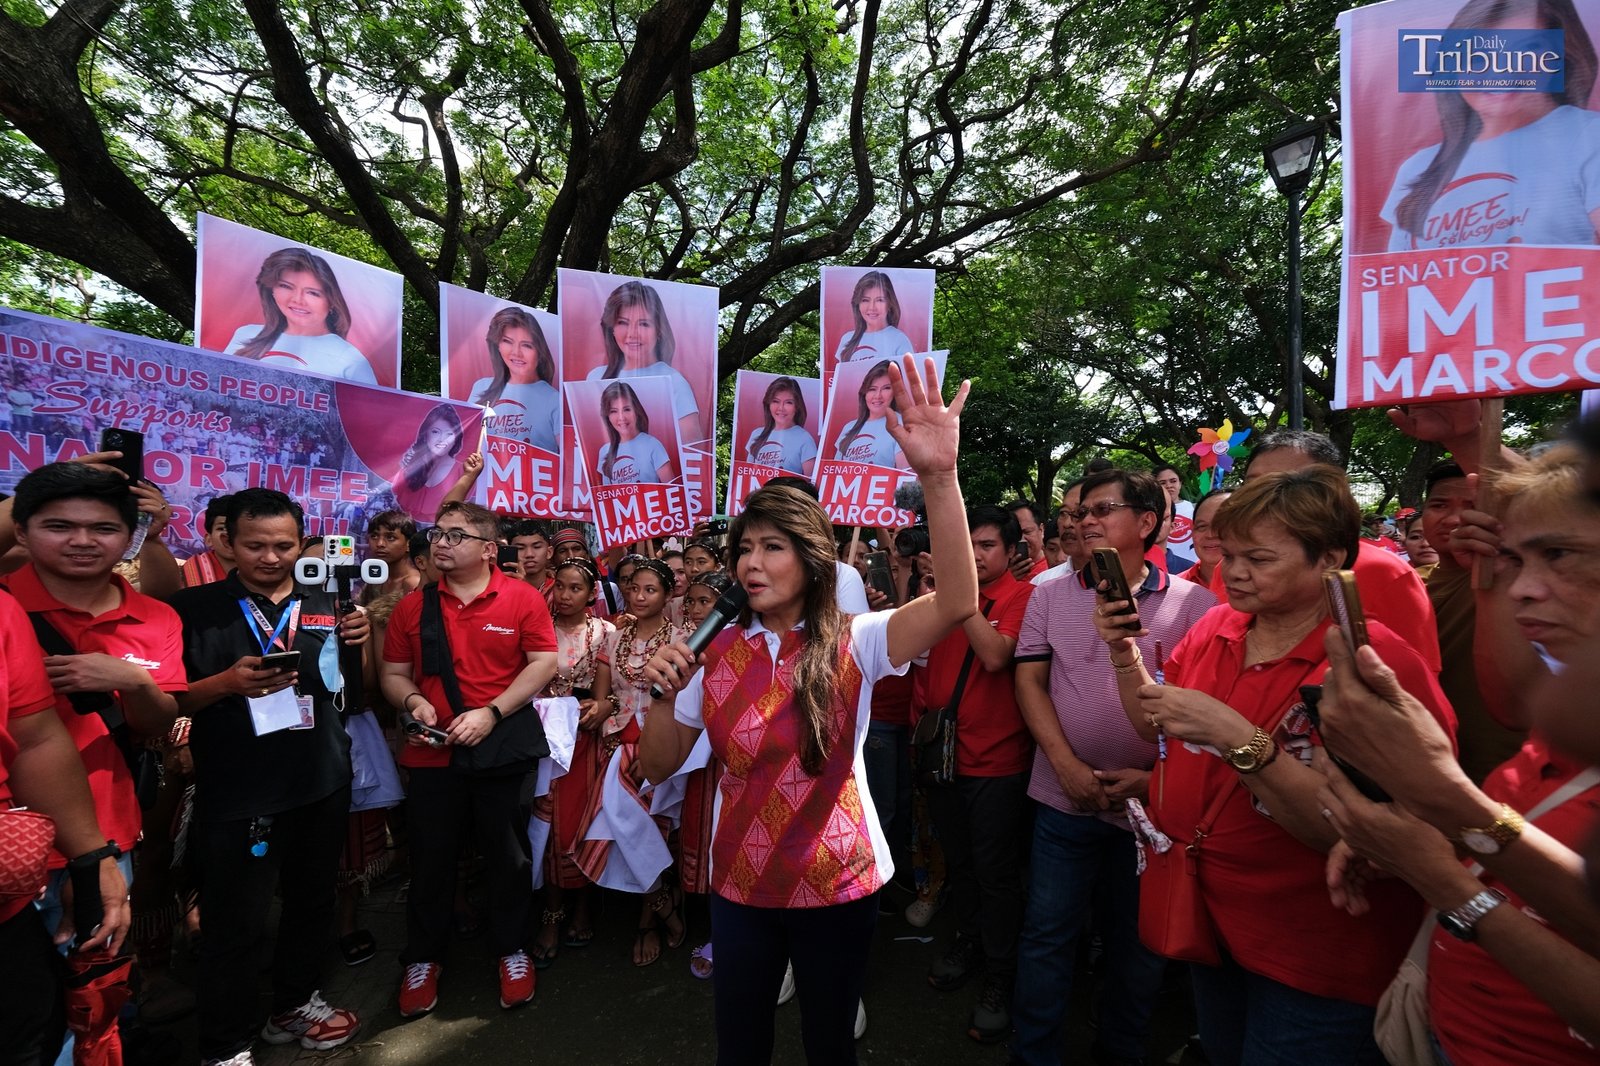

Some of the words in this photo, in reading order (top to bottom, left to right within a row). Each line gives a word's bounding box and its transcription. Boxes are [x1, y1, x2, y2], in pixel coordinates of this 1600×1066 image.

[1424, 193, 1510, 241] IMEE
[1361, 251, 1510, 288] SENATOR
[31, 379, 232, 434] Supports
[219, 374, 331, 413] PEOPLE
[0, 429, 229, 491] NAOR
[247, 460, 369, 502] IMEE
[488, 441, 527, 455] ATOR
[845, 443, 872, 458] IMEE
[487, 453, 554, 494] ME
[737, 466, 780, 478] SENATOR
[823, 465, 869, 475] SENATOR
[488, 489, 584, 519] ARCO
[596, 485, 639, 501] SENATOR
[598, 486, 684, 529] IMEE
[604, 512, 685, 547] MARCOS
[824, 503, 910, 527] ARCOS
